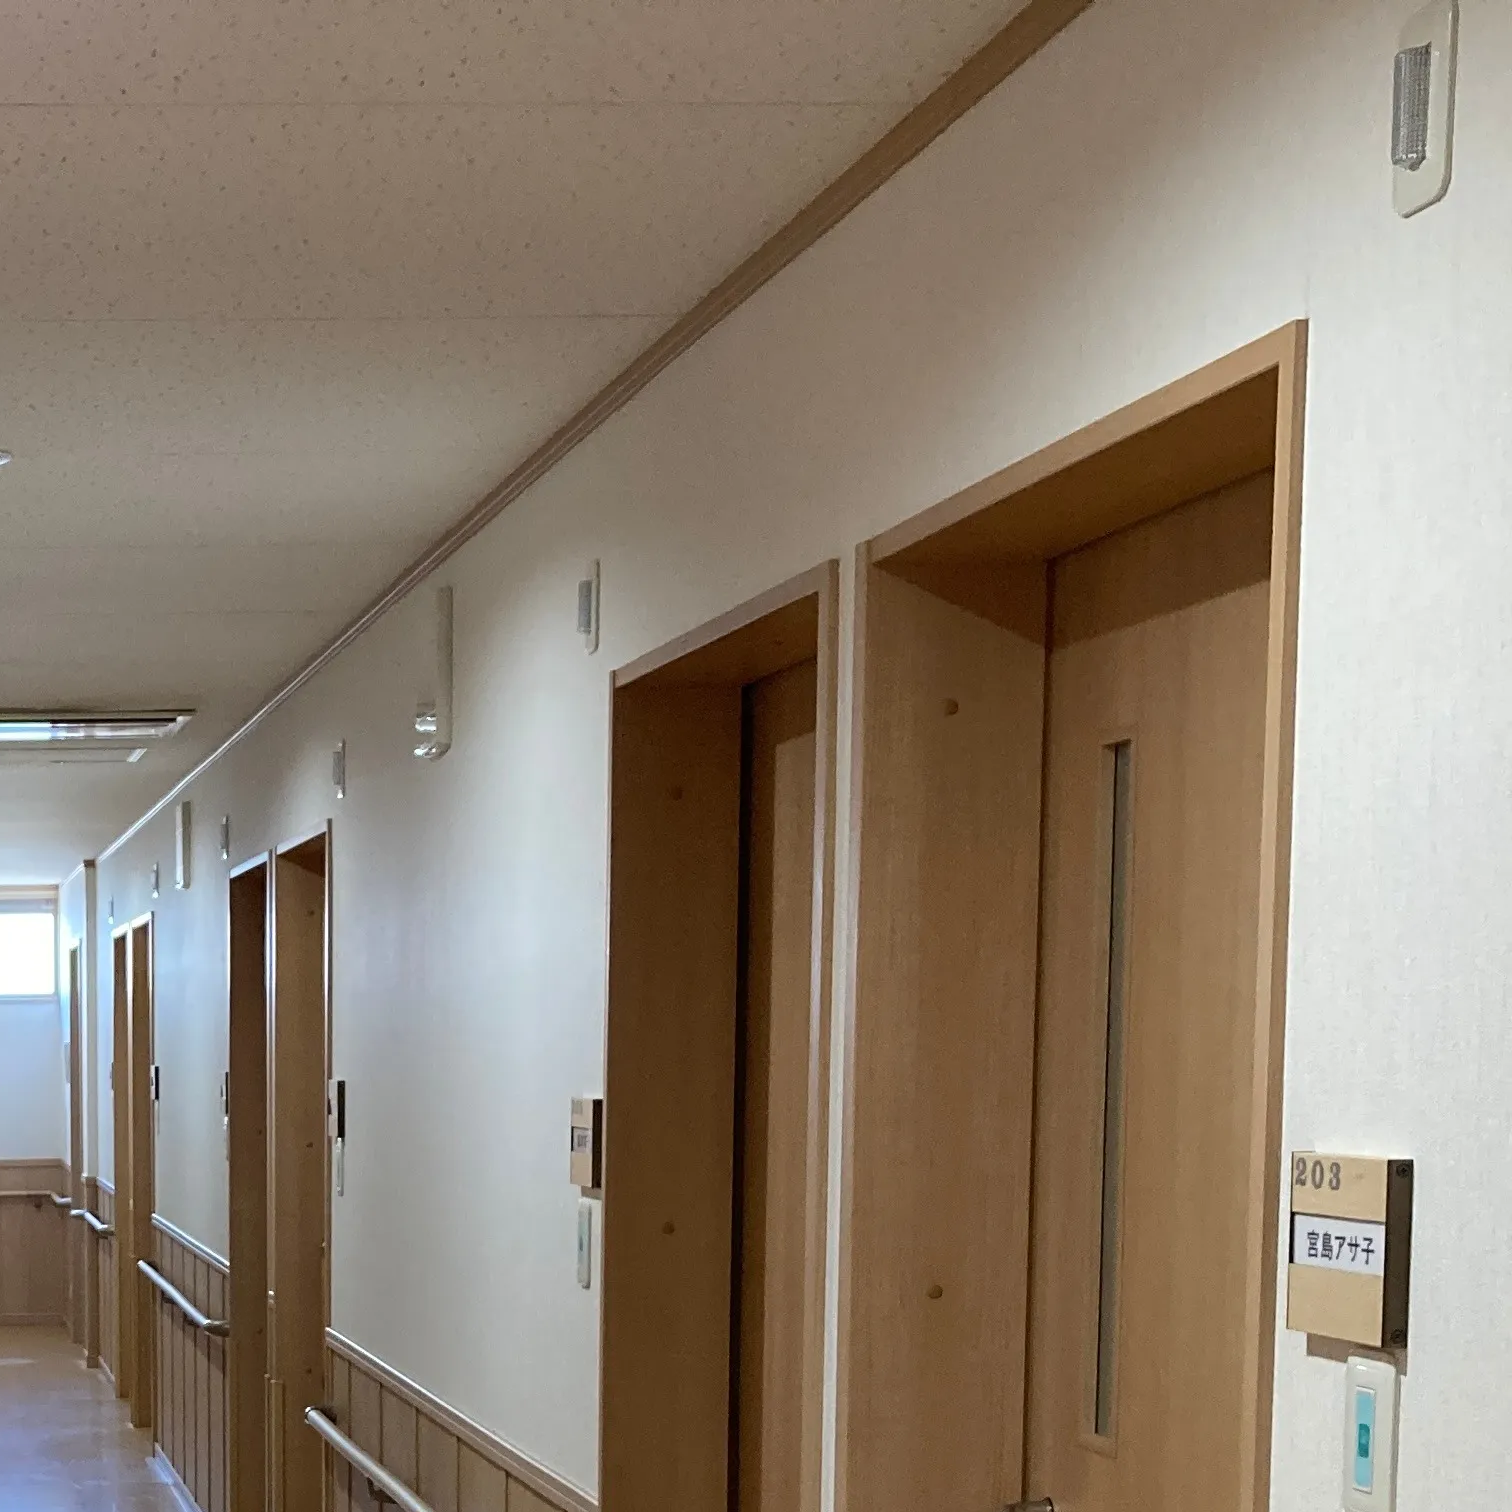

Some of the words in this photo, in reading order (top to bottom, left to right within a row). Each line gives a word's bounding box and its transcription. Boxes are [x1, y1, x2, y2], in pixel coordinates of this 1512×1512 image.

[1295, 1157, 1341, 1190] 203
[1307, 1229, 1375, 1265] 宮島アサ子
